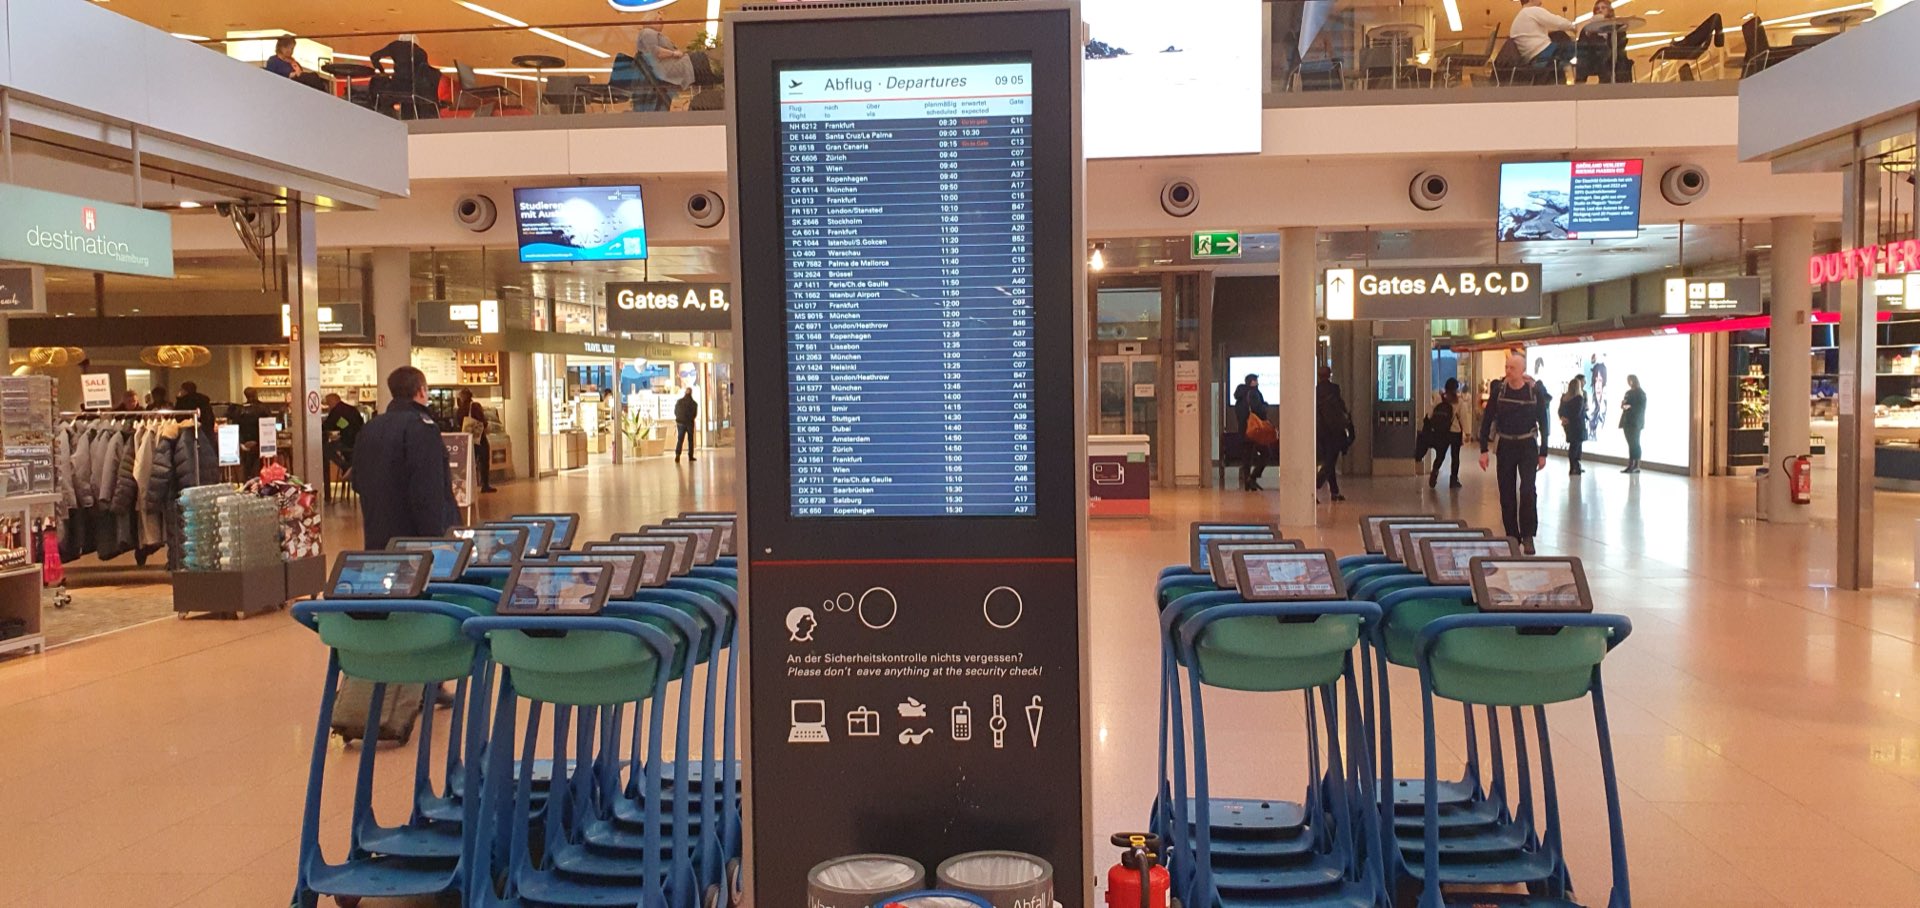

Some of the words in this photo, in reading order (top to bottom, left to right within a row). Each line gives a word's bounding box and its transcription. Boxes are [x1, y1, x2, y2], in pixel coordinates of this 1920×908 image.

[824, 77, 872, 93] Abflug
[886, 75, 967, 91] Departures
[995, 76, 1008, 86] 09
[1011, 75, 1024, 85] 05
[789, 112, 806, 120] Flight
[824, 121, 855, 129] Frankfurt
[938, 118, 957, 126] 08:30
[824, 132, 844, 140] Santa
[871, 130, 893, 139] Palma
[938, 129, 957, 137] 09:00
[824, 143, 842, 151] Gran
[842, 142, 869, 150] Canaria
[938, 139, 958, 148] 09:15
[1010, 137, 1024, 146] C13
[825, 153, 847, 161] Zürich
[1010, 148, 1024, 157] C07
[825, 164, 843, 172] Wien
[825, 175, 868, 184] Kopenhagen
[1010, 170, 1024, 178] A37
[825, 185, 858, 193] München
[1010, 181, 1024, 189] A17
[826, 196, 857, 204] Frankfurt
[1011, 202, 1025, 210] B47
[521, 210, 537, 219] mit
[826, 217, 863, 225] Stockholm
[827, 227, 857, 236] Frankfurt
[1010, 223, 1025, 232] A20
[27, 225, 129, 258] destination
[1011, 234, 1025, 242] B52
[827, 249, 861, 257] Warschau
[115, 252, 149, 266] hamburg
[827, 259, 849, 267] Palma
[849, 259, 859, 267] de
[859, 259, 889, 267] Mallorca
[828, 270, 853, 278] Brüssel
[1011, 266, 1025, 274] A17
[866, 280, 889, 288] Gaulle
[1011, 277, 1026, 285] A40
[1359, 273, 1425, 295] Gates
[1431, 273, 1456, 297] A,
[1459, 273, 1482, 297] B,
[1484, 272, 1507, 296] C,
[1511, 272, 1529, 293] D
[828, 291, 856, 299] Istanbul
[1011, 287, 1025, 295] C04
[617, 289, 679, 310] Gates
[682, 289, 707, 312] A,
[709, 290, 729, 312] B,
[828, 301, 859, 309] Frankfurt
[828, 311, 861, 319] München
[829, 332, 871, 342] Kopenhagen
[1012, 329, 1026, 337] A37
[584, 342, 602, 352] TRAVEL
[1012, 350, 1026, 358] A20
[830, 363, 857, 371] Helsinki
[1012, 360, 1026, 368] C07
[84, 378, 107, 387] SALE
[1012, 381, 1026, 389] A41
[830, 394, 861, 402] Frankfurt
[1013, 402, 1027, 410] C04
[831, 414, 861, 423] Stuttgart
[831, 445, 853, 453] Zürich
[832, 455, 862, 463] Frankfurt
[1013, 453, 1027, 461] C07
[870, 475, 892, 483] Gaulle
[832, 486, 874, 494] Saarbrücken
[832, 496, 862, 506] Salzburg
[833, 507, 875, 515] Kopenhagen
[1014, 505, 1028, 513] A37
[787, 653, 802, 663] An
[804, 652, 822, 663] der
[824, 652, 928, 663] Sicherheitskontrolle
[930, 652, 961, 663] nichts
[964, 652, 1023, 665] vergessen?
[787, 666, 821, 677] Please
[824, 666, 851, 677] don't
[856, 668, 882, 677] eave
[884, 666, 930, 679] anything
[932, 667, 944, 676] at
[946, 666, 963, 676] the
[965, 665, 1007, 678] security
[1009, 665, 1043, 677] check!
